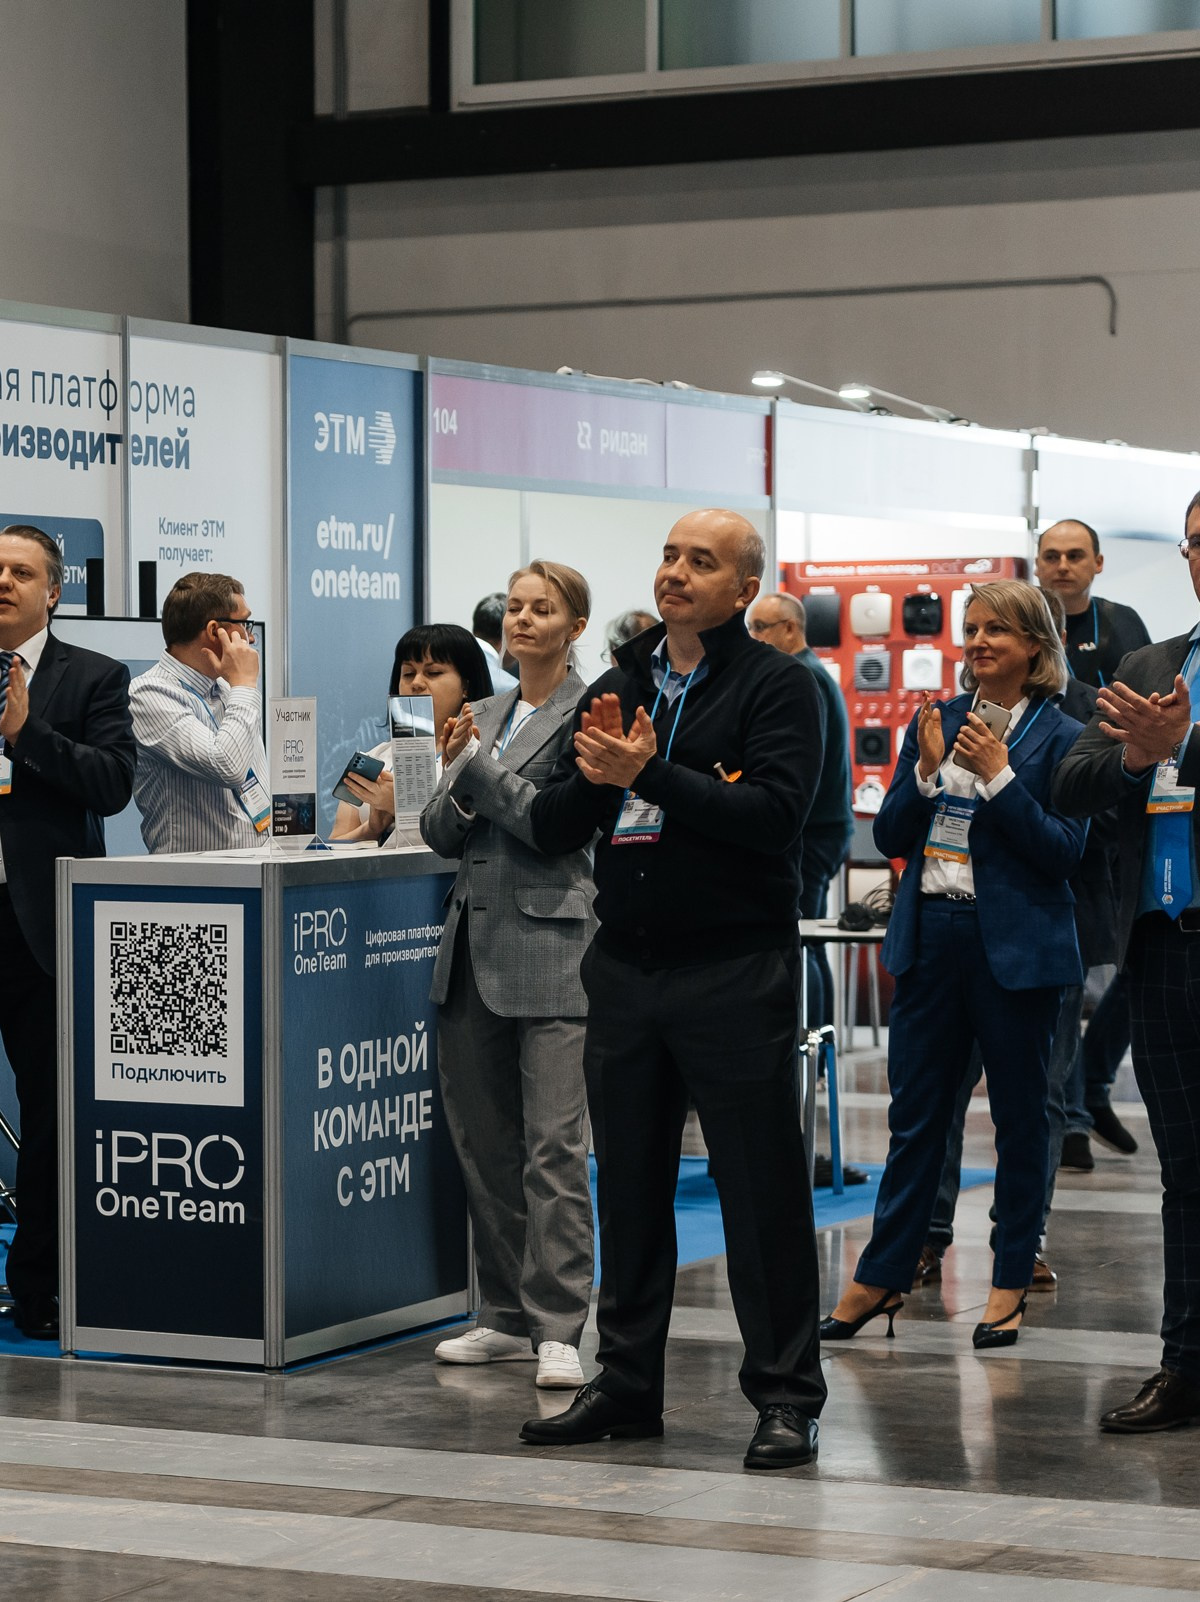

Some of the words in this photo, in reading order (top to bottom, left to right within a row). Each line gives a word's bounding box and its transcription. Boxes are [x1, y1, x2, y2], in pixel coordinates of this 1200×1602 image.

[31, 369, 196, 423] платформа
[313, 411, 365, 456] ЭТМ
[433, 407, 458, 435] 104
[158, 517, 199, 537] Клиент
[201, 519, 225, 538] ЭТМ
[316, 513, 395, 560] etm.ru/
[158, 545, 213, 567] получает:
[311, 566, 400, 600] oneteam
[275, 708, 311, 722] Участник
[294, 908, 347, 951] iPRO
[365, 929, 406, 947] Цифровая
[407, 923, 446, 941] платформ
[294, 951, 347, 975] OneTeam
[365, 953, 380, 968] для
[111, 1062, 227, 1084] Подключить
[317, 1047, 333, 1089] В
[339, 1021, 428, 1091] ОДНОЙ
[313, 1089, 433, 1151] КОМАНДЕ
[95, 1129, 245, 1190] iPRO
[336, 1165, 353, 1207] С
[360, 1153, 410, 1203] ЭТМ
[95, 1187, 245, 1224] OneTeam
